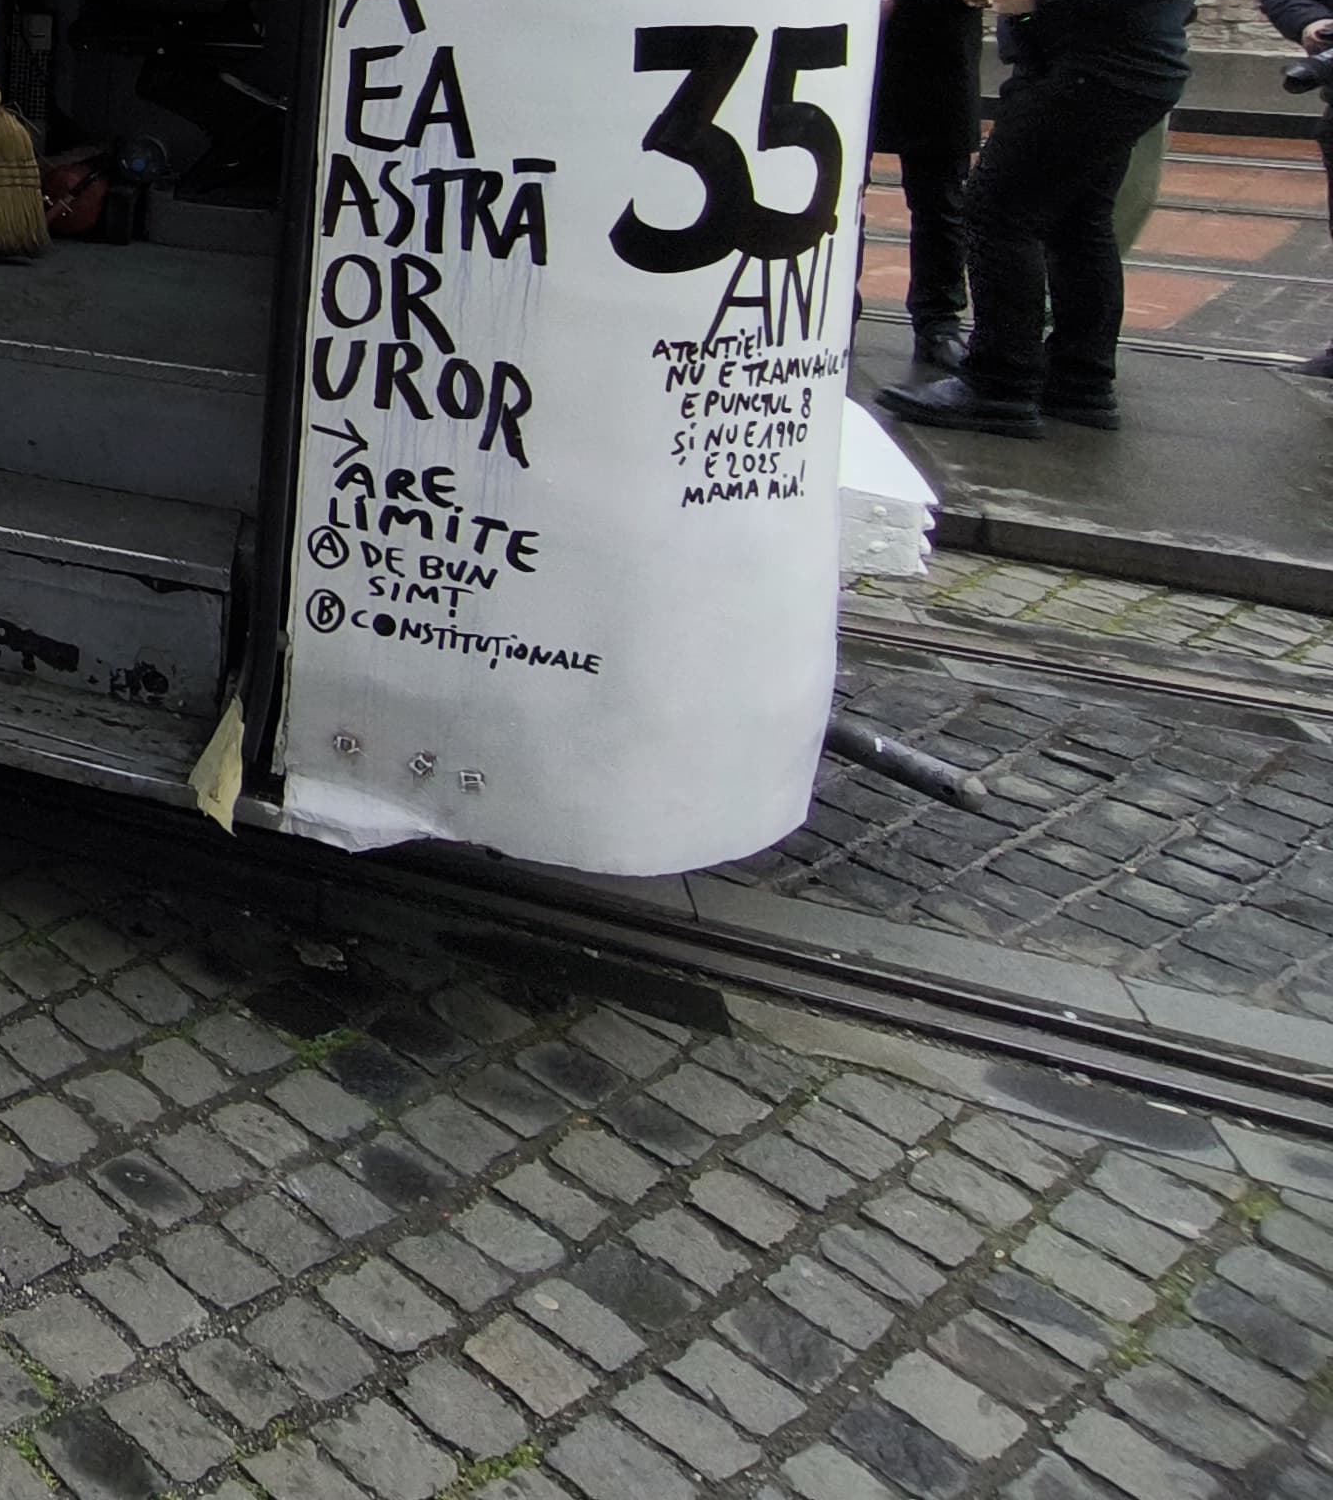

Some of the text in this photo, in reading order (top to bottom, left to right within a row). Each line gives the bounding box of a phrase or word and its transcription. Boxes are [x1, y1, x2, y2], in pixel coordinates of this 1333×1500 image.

[345, 44, 475, 158] EA
[608, 24, 848, 273] 35
[321, 253, 456, 355] OR
[666, 363, 705, 392] NU
[719, 361, 737, 388] E
[312, 336, 530, 468] UROR
[681, 387, 812, 418] E PUNCTUL 8
[704, 423, 739, 452] NU
[744, 420, 758, 445] E
[757, 420, 808, 449] 1990
[334, 462, 456, 509] ARE
[705, 452, 781, 478] E 2025
[681, 479, 759, 508] MAMA
[359, 540, 406, 578] DE
[419, 555, 499, 590] BUN
